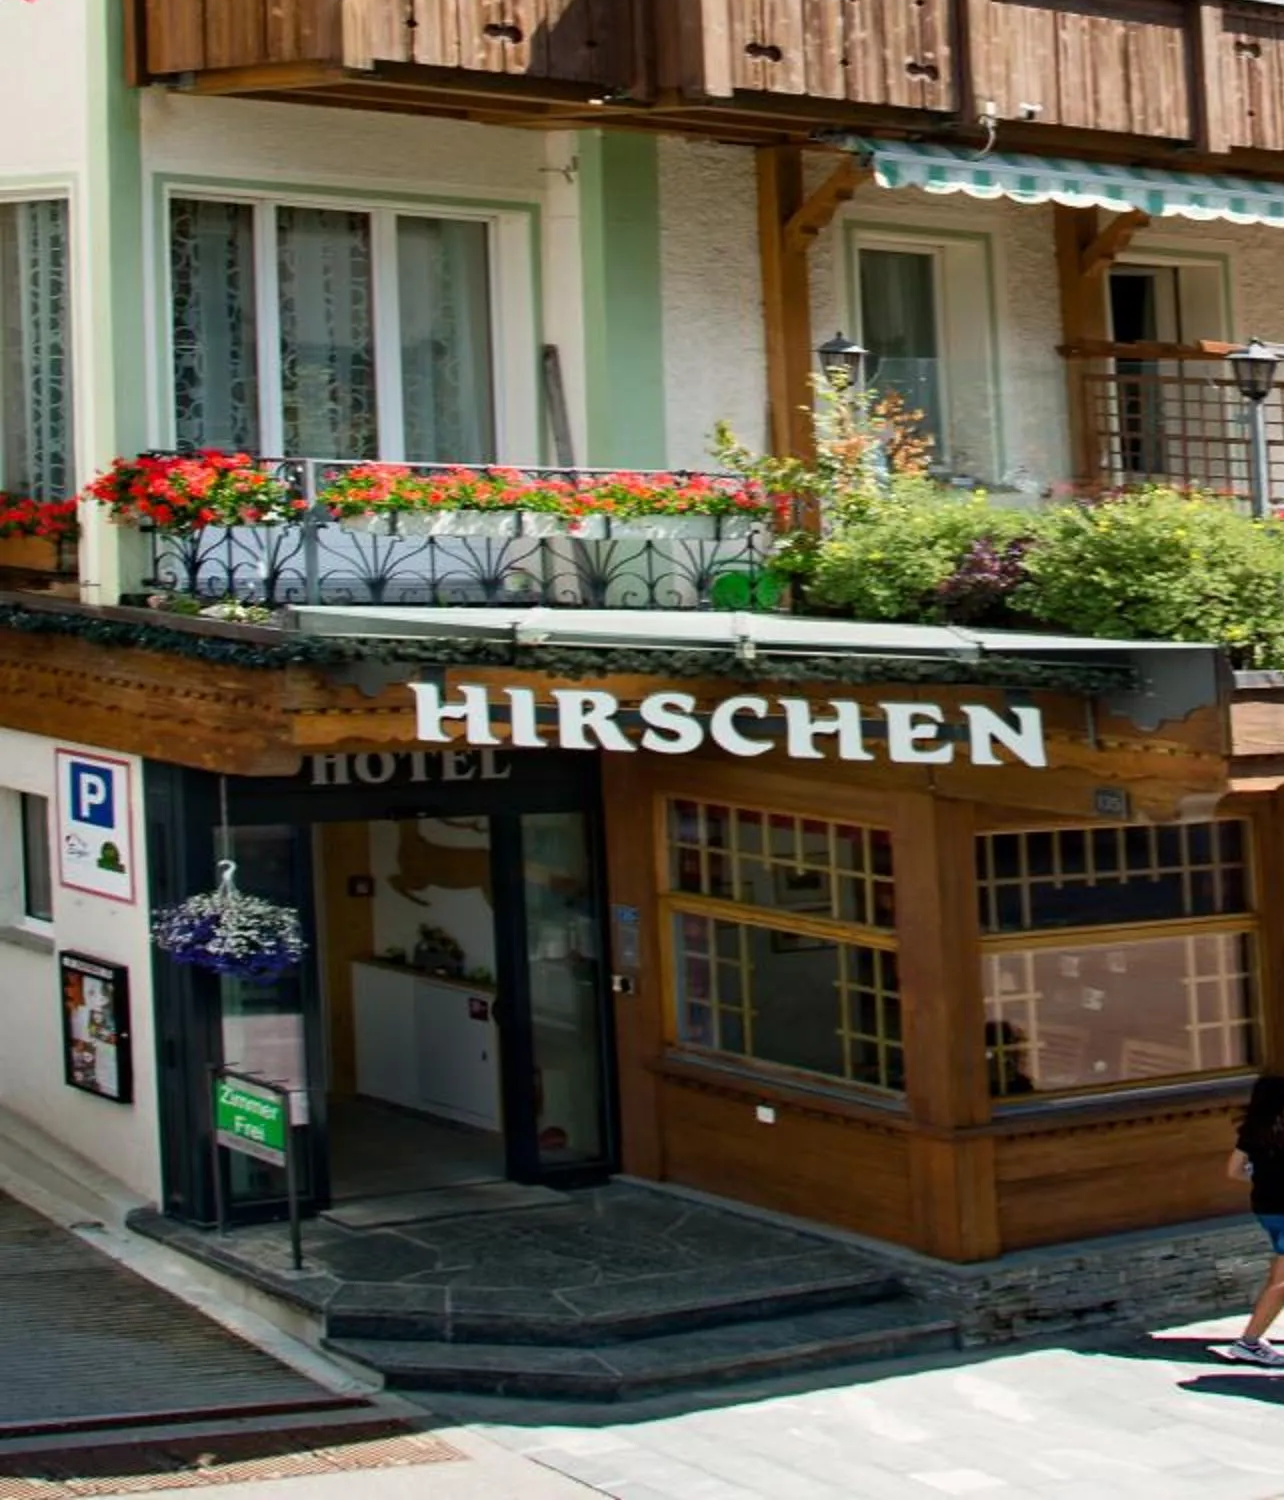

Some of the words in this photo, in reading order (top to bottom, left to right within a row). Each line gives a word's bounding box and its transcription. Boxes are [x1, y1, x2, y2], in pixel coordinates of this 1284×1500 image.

[407, 682, 1048, 768] HIRSCHEN
[311, 750, 512, 785] HOTEL
[79, 771, 106, 819] P
[220, 1084, 279, 1120] Zimmer
[234, 1115, 265, 1141] Frei
